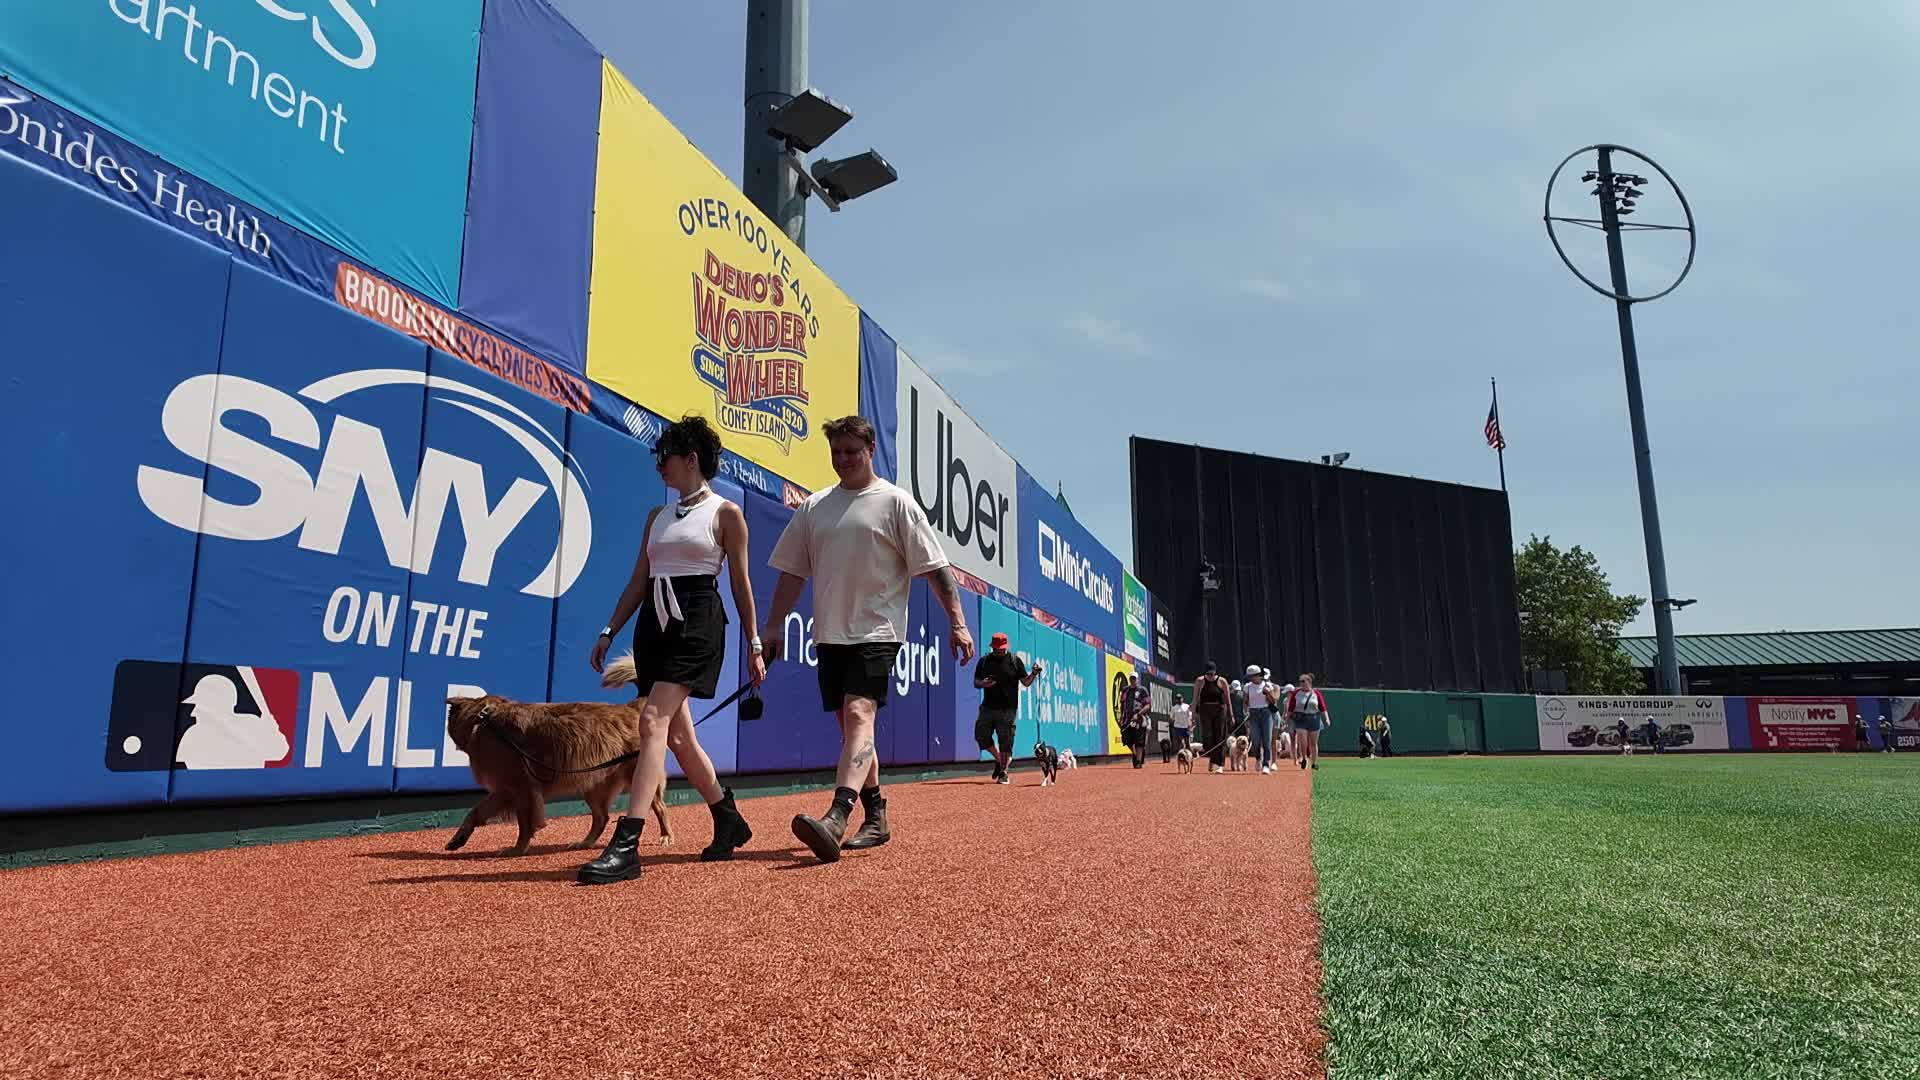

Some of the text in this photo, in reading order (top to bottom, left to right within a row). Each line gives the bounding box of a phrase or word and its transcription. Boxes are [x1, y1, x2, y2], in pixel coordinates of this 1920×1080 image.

[152, 169, 271, 259] Health
[678, 198, 821, 340] OVER 100 YEARS
[703, 247, 785, 308] DENO'S
[691, 271, 809, 358] WONDER
[699, 354, 725, 382] SINCE
[723, 351, 809, 406] WHEEL
[720, 404, 787, 443] CONEY ISLAND
[781, 405, 803, 432] 1920
[137, 373, 548, 587] SNY
[910, 385, 1009, 569] Uber
[1055, 534, 1114, 614] Mini-Circuits
[322, 585, 488, 659] ON THE
[1053, 662, 1084, 697] Get Your
[1054, 696, 1098, 734] Money Right
[1771, 708, 1837, 723] Notify NYC
